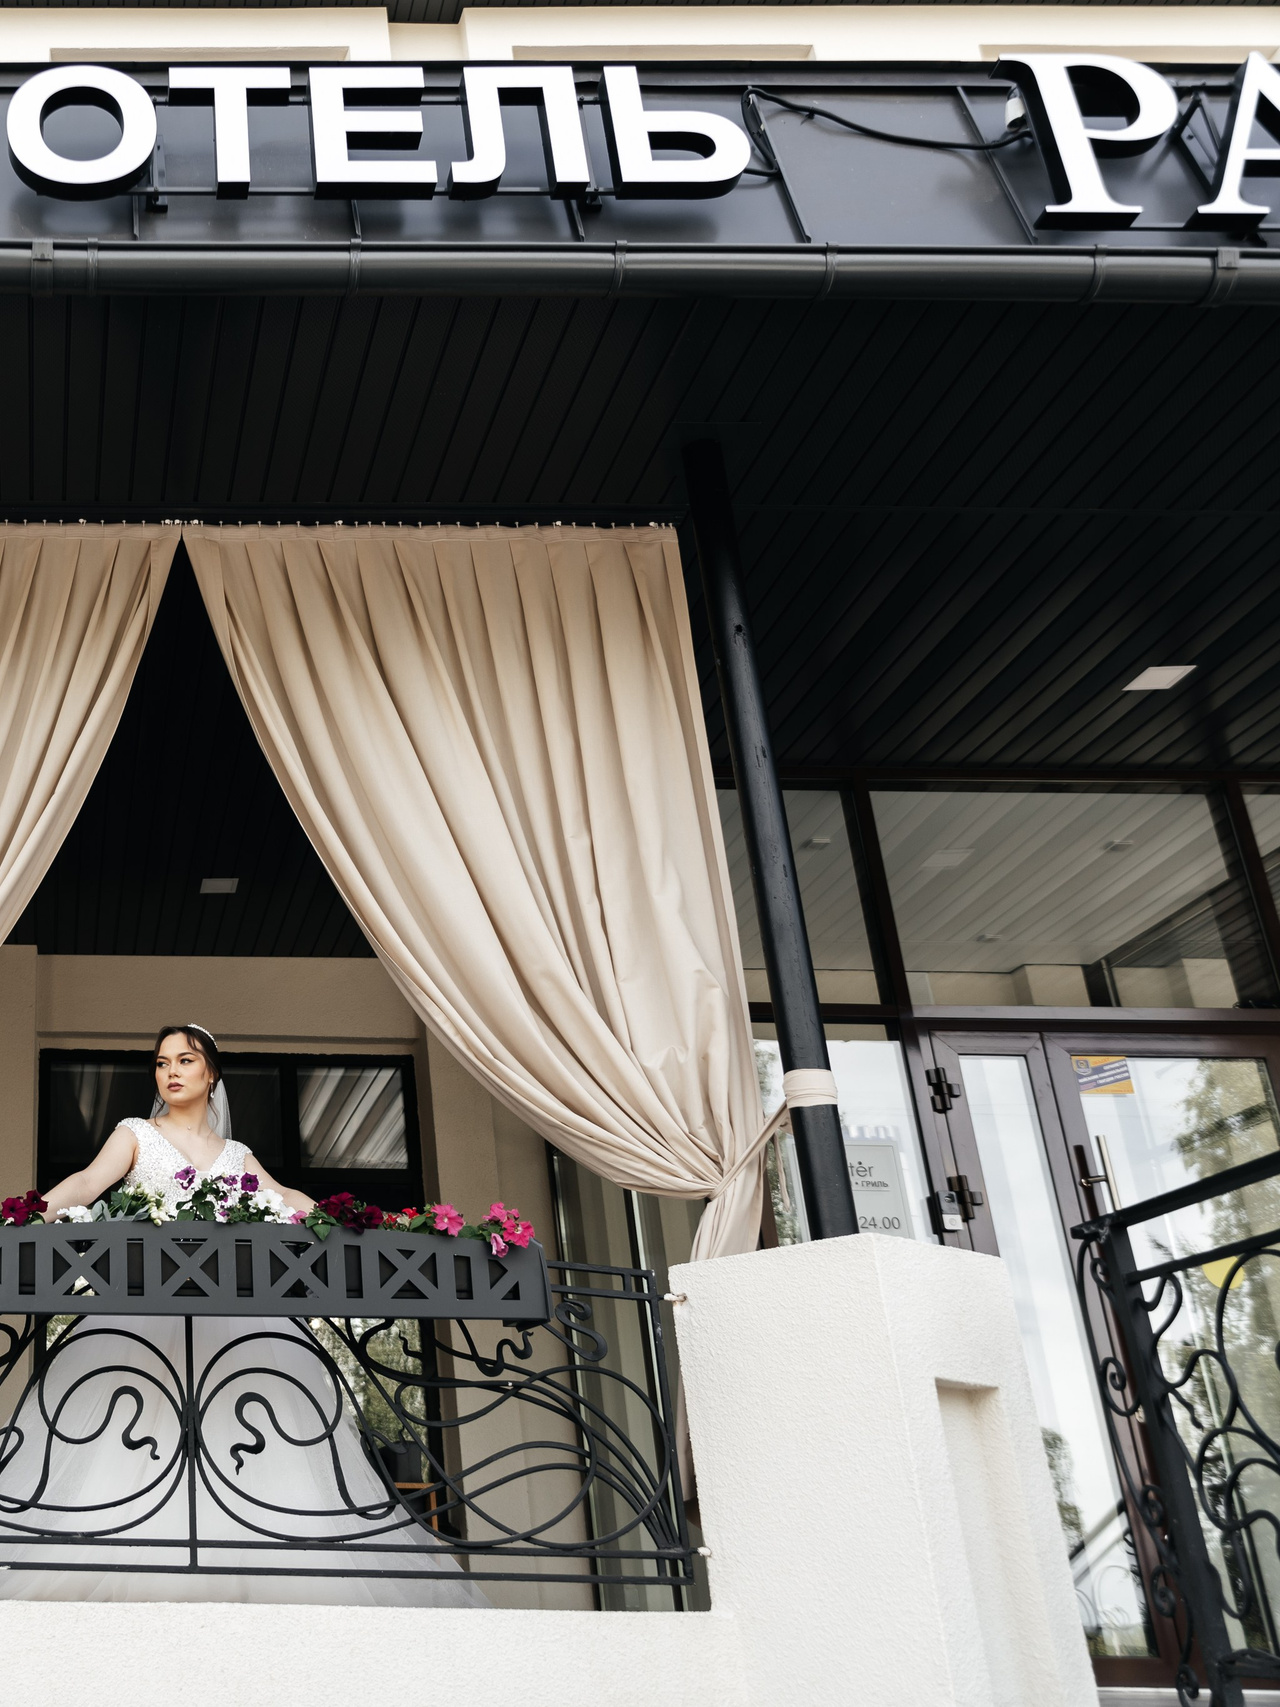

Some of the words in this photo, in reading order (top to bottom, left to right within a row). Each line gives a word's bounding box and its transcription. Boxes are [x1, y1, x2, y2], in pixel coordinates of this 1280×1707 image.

[6, 64, 751, 188] ОТЕЛЬ
[861, 1180, 890, 1188] ГРИЛЬ
[858, 1215, 901, 1230] 24.00
